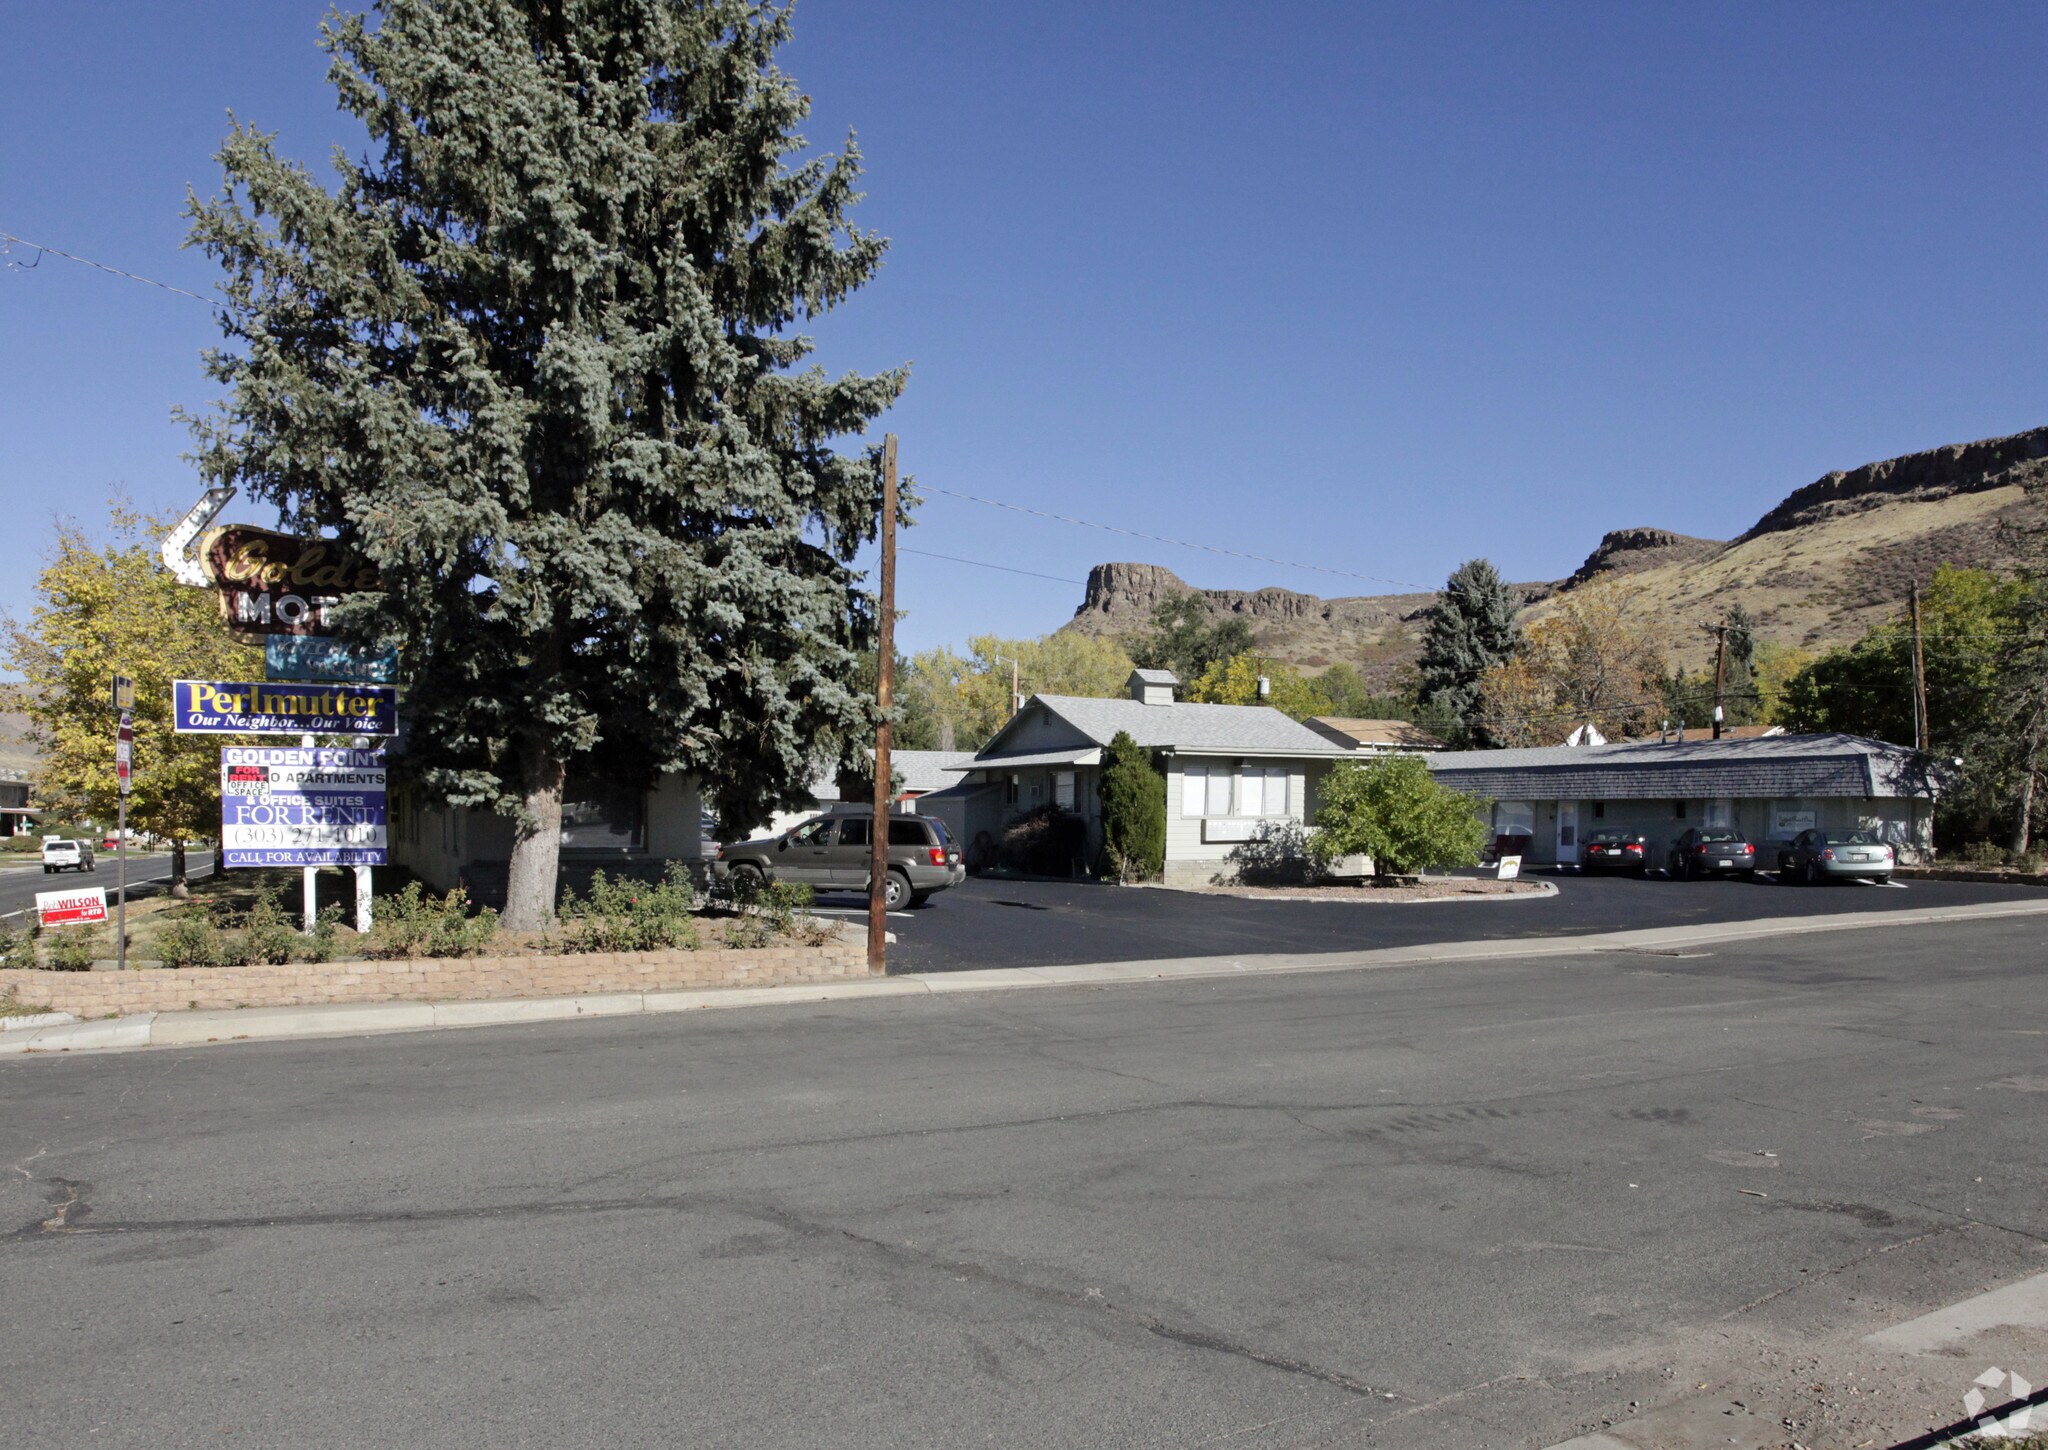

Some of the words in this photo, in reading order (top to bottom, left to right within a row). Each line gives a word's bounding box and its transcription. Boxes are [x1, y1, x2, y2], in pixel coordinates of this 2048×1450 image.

[225, 540, 380, 588] Golde
[187, 683, 385, 717] Perlmutter
[189, 713, 220, 726] Our
[345, 717, 383, 730] Voice
[227, 749, 314, 765] GOLDEN
[320, 751, 379, 766] POINT
[235, 766, 260, 774] FOR
[286, 773, 385, 784] APARTMENTS
[246, 796, 255, 805] &
[259, 795, 310, 806] OFFICE
[314, 796, 364, 806] SUITES
[236, 806, 291, 825] FOR
[301, 807, 374, 825] RENT
[235, 828, 284, 846] (303)
[292, 828, 377, 844] 271-1010
[228, 852, 261, 863] CALL
[266, 852, 292, 862] FOR
[296, 851, 382, 863] AVAILABILITY
